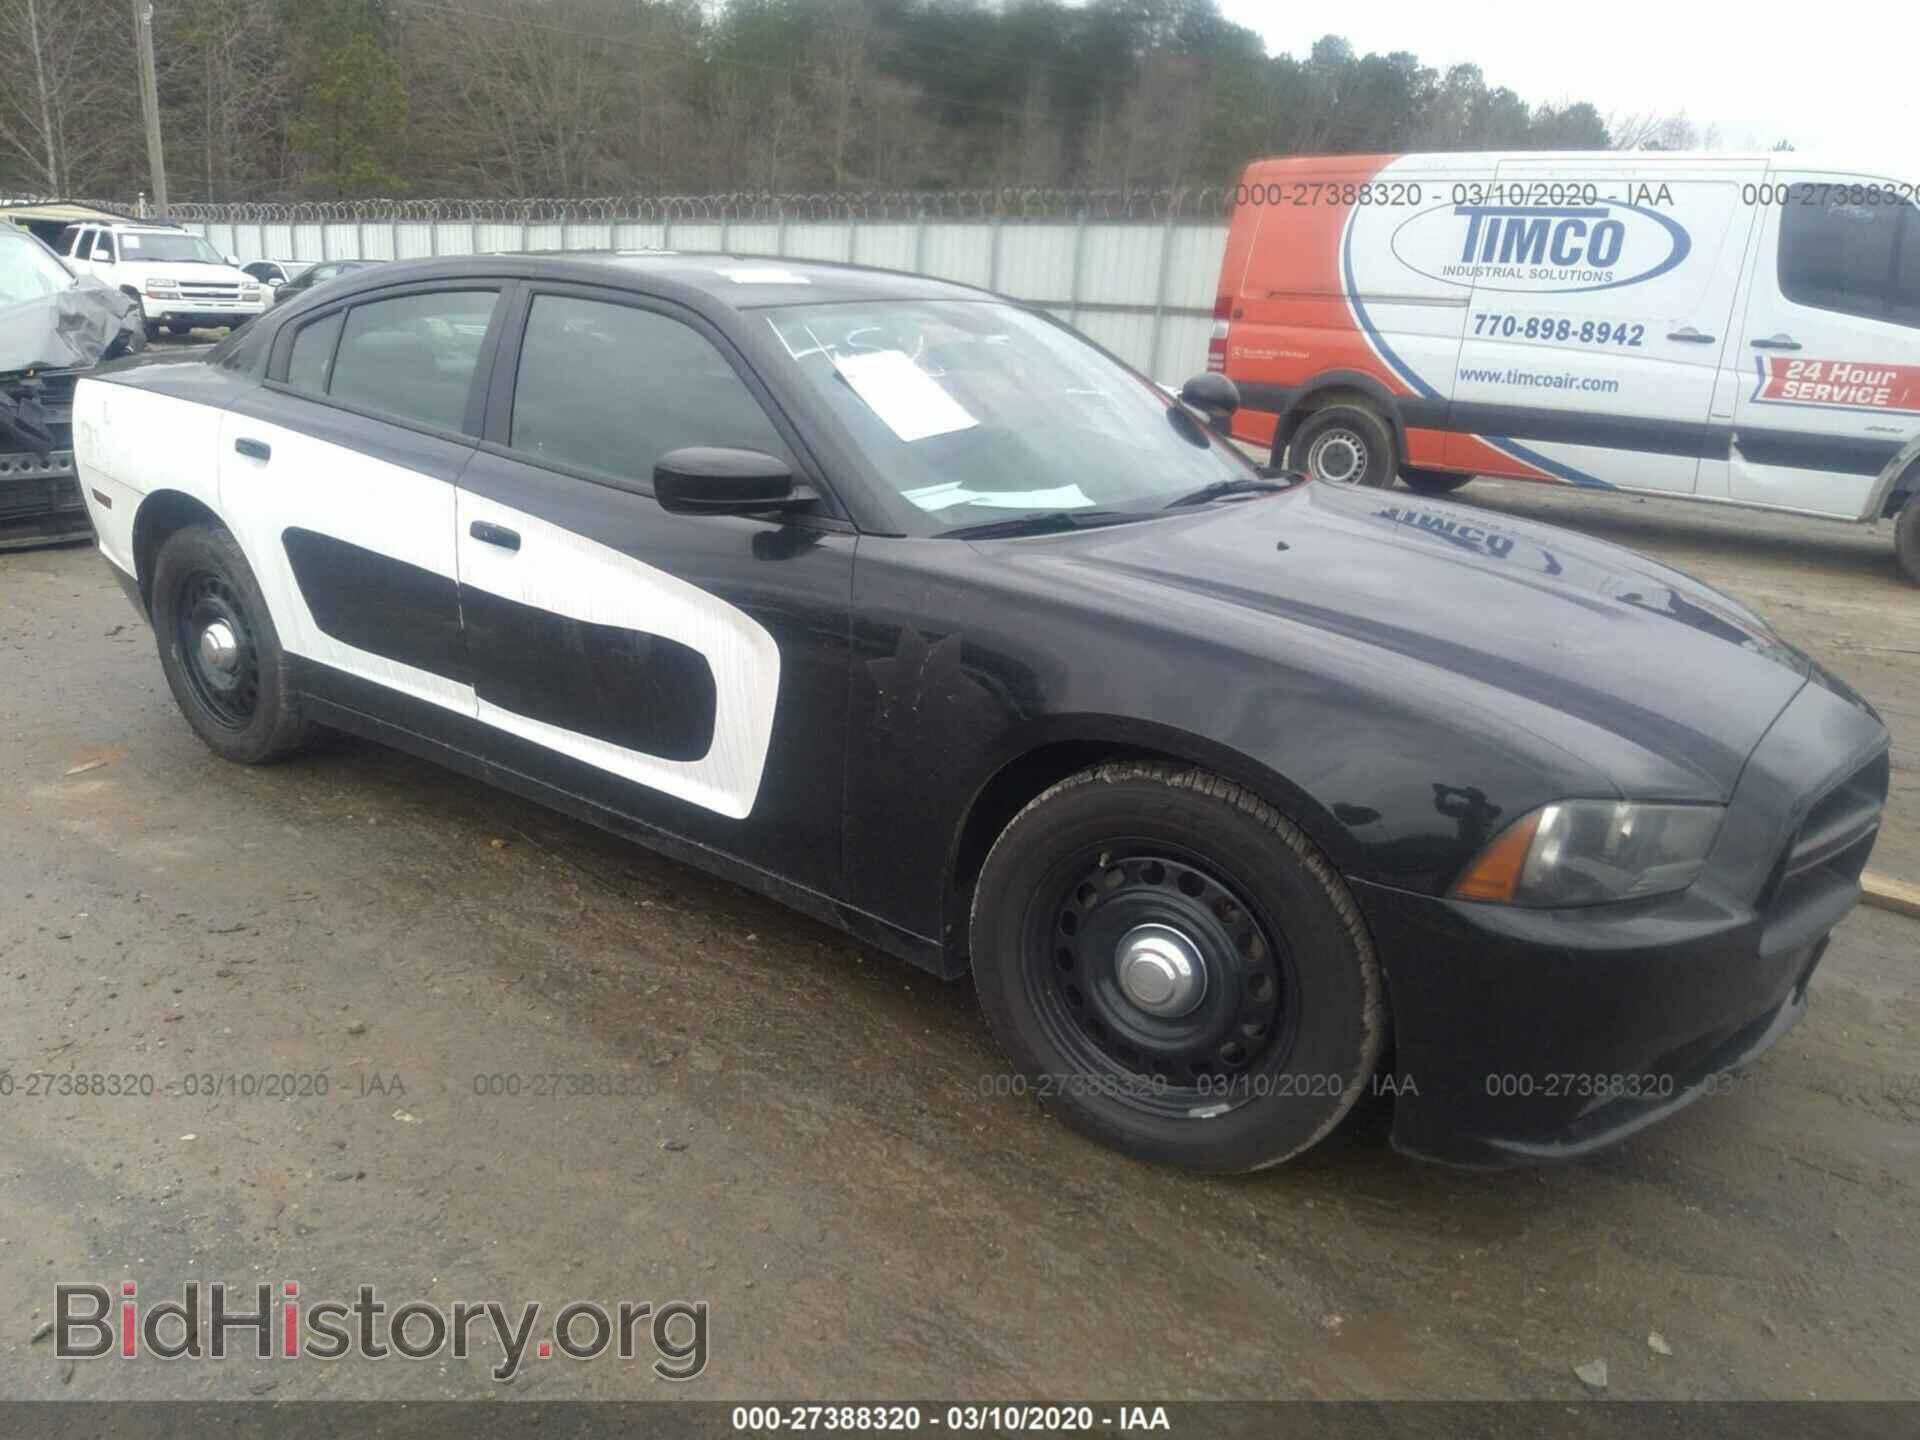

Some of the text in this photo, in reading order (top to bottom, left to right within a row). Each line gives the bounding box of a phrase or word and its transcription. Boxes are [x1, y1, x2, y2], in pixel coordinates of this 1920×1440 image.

[1454, 205, 1626, 268] TIMCO
[1442, 265, 1614, 282] INDUSTRIAL SOLUTIONS
[1474, 313, 1645, 346] 770-898-8942
[1459, 368, 1620, 393] www.timcoair.com
[1785, 360, 1897, 386] 24 Hour
